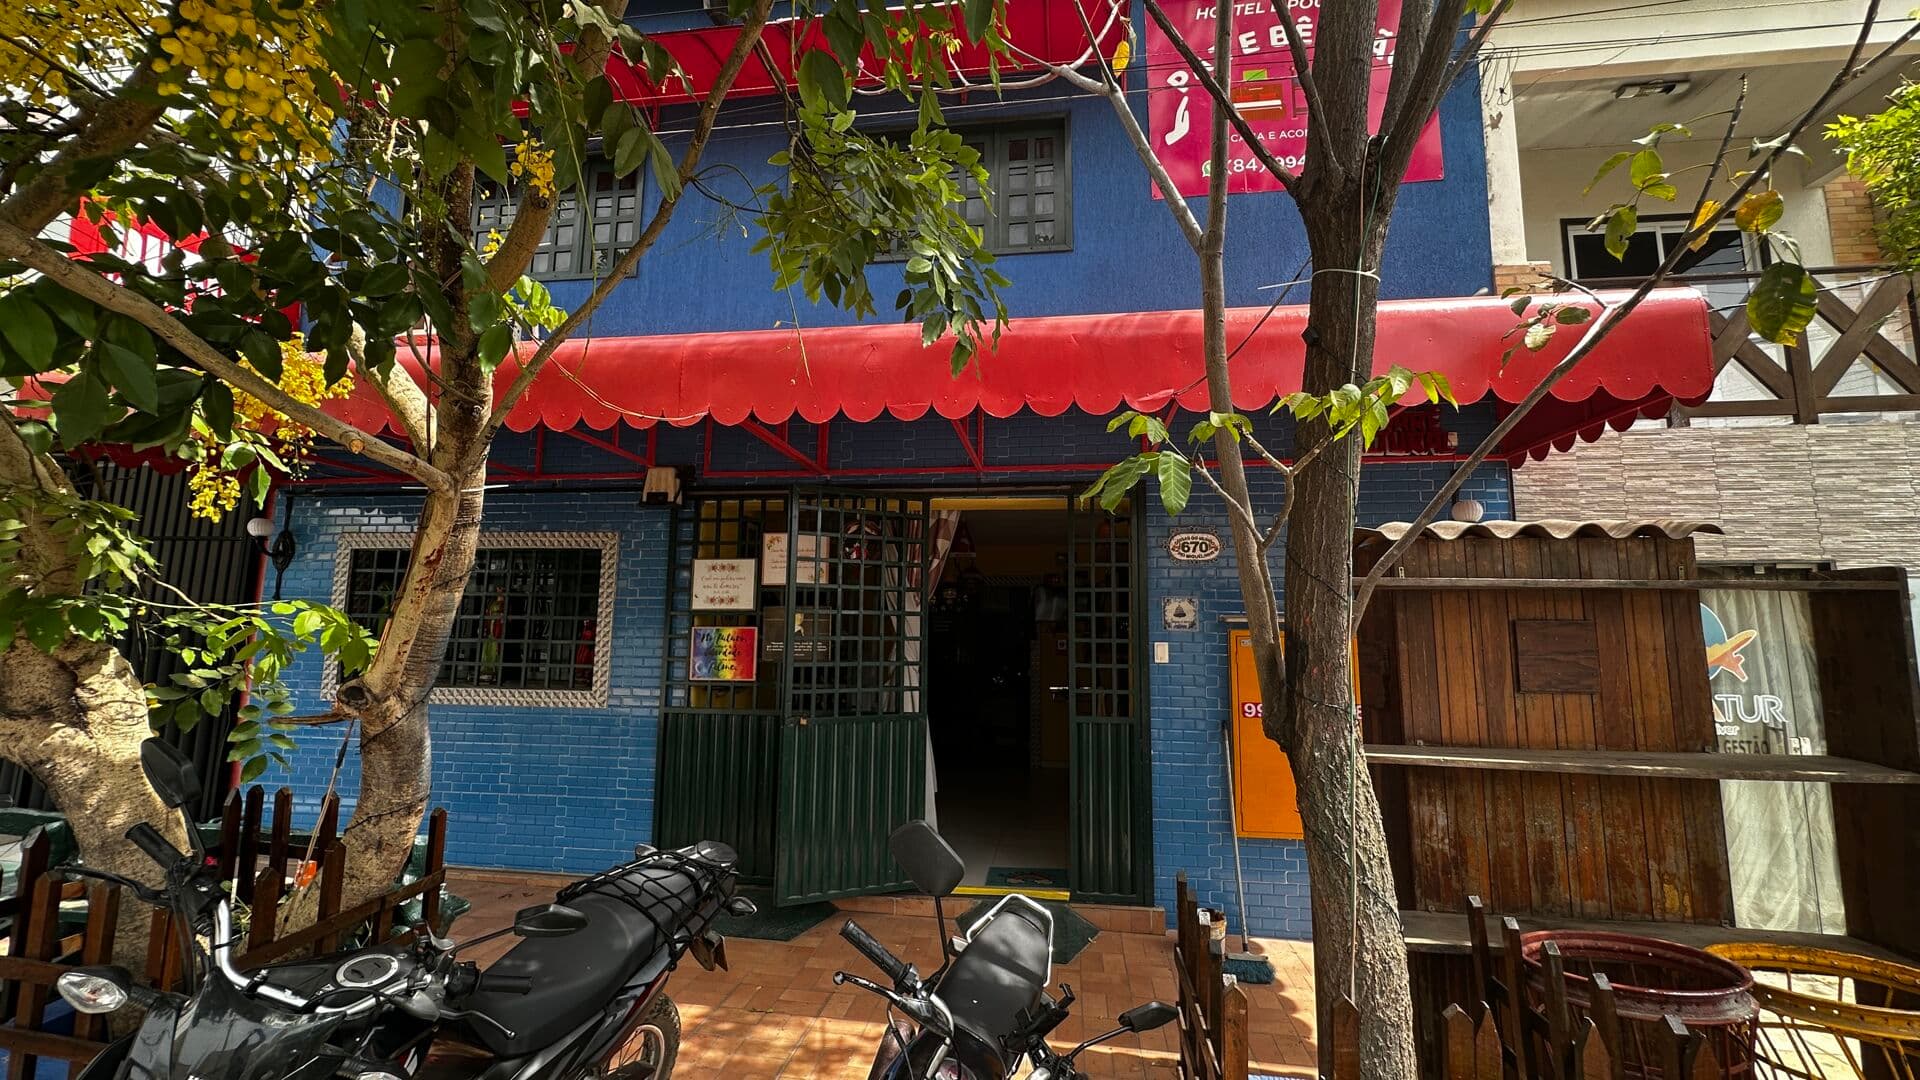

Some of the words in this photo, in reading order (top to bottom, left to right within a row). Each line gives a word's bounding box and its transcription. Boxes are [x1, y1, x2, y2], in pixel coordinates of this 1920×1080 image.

[1196, 3, 1266, 20] HOTEL
[1181, 541, 1209, 553] 670
[1723, 736, 1769, 755] GESTÃO
